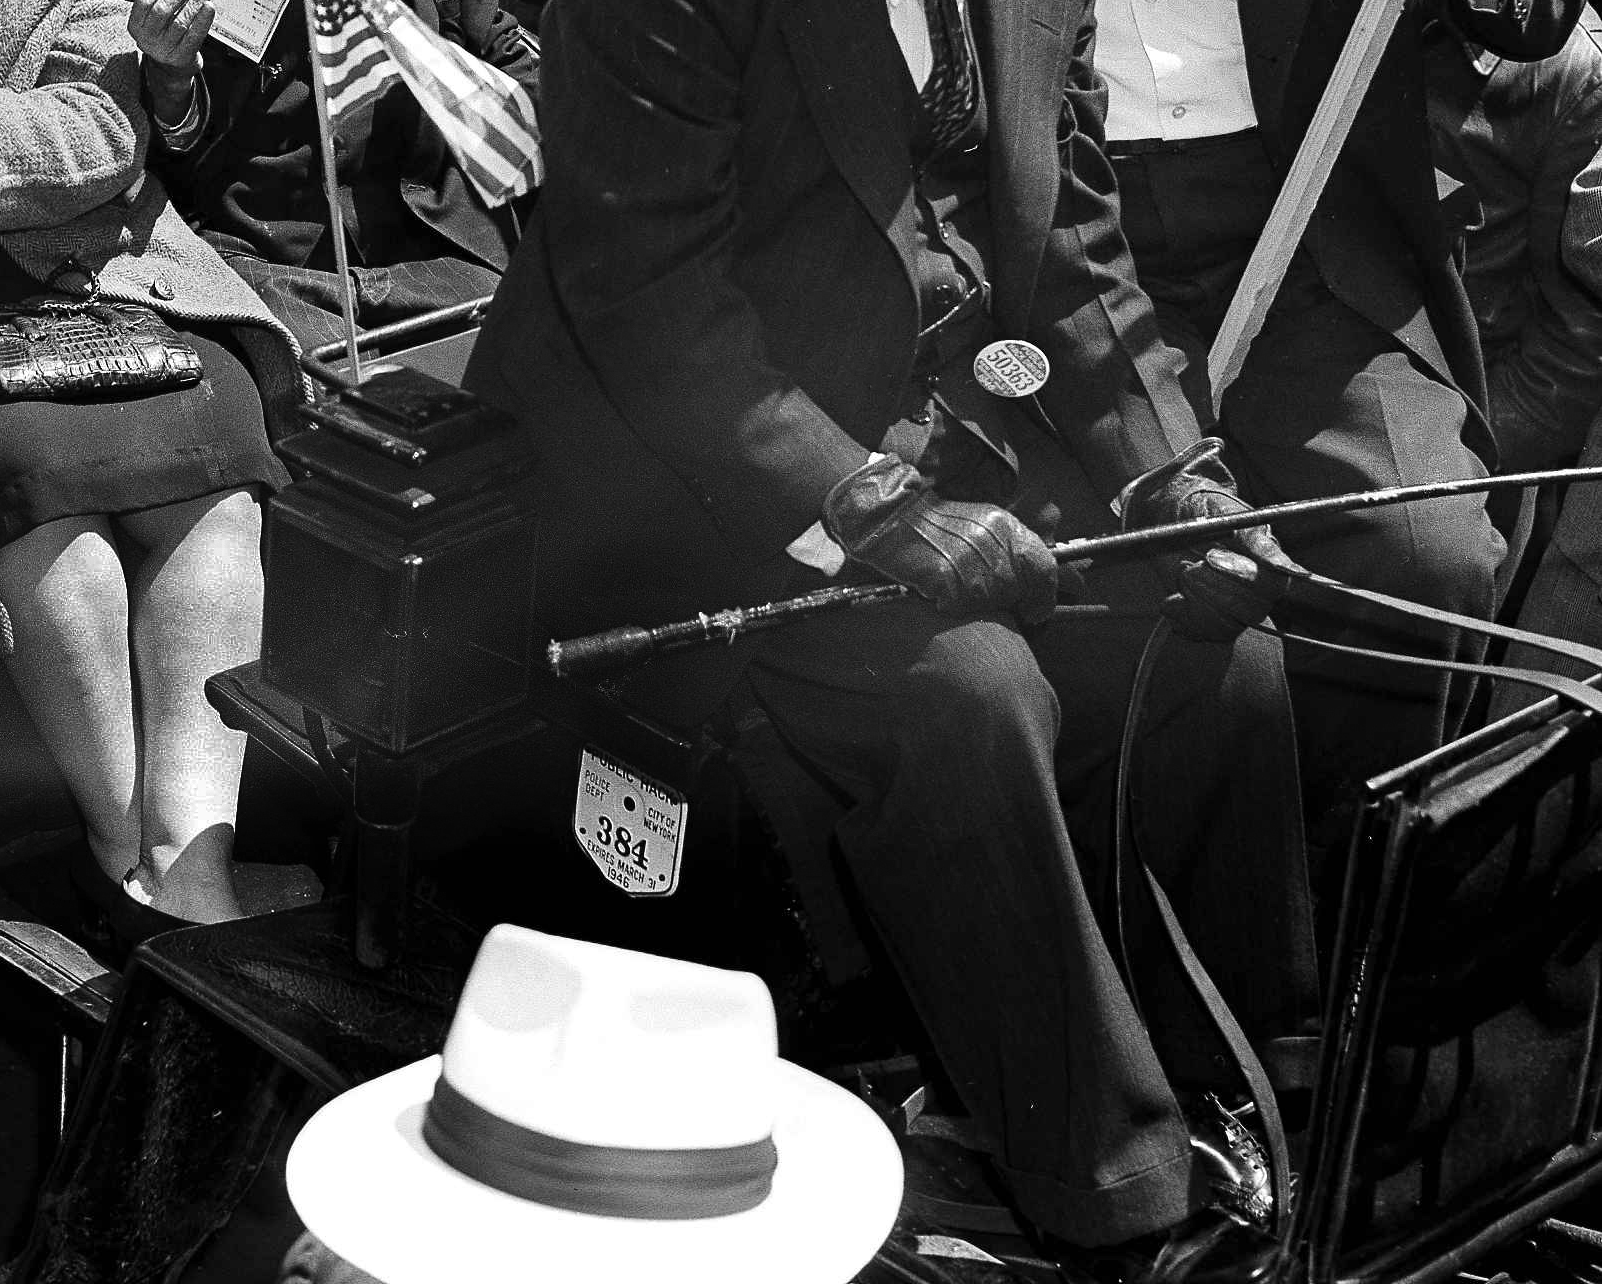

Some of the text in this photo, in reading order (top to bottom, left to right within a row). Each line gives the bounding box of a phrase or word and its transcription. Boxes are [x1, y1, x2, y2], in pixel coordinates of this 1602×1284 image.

[987, 349, 1035, 391] 50363
[585, 770, 611, 793] POLICE
[590, 750, 674, 806] PUBLIC HACK
[585, 783, 605, 802] DEPT
[648, 807, 676, 827] CITY OF
[596, 815, 648, 871] 384
[644, 818, 677, 843] NEW YORK
[586, 839, 657, 890] EXPIRES MARCH 31
[607, 866, 630, 889] 1946
